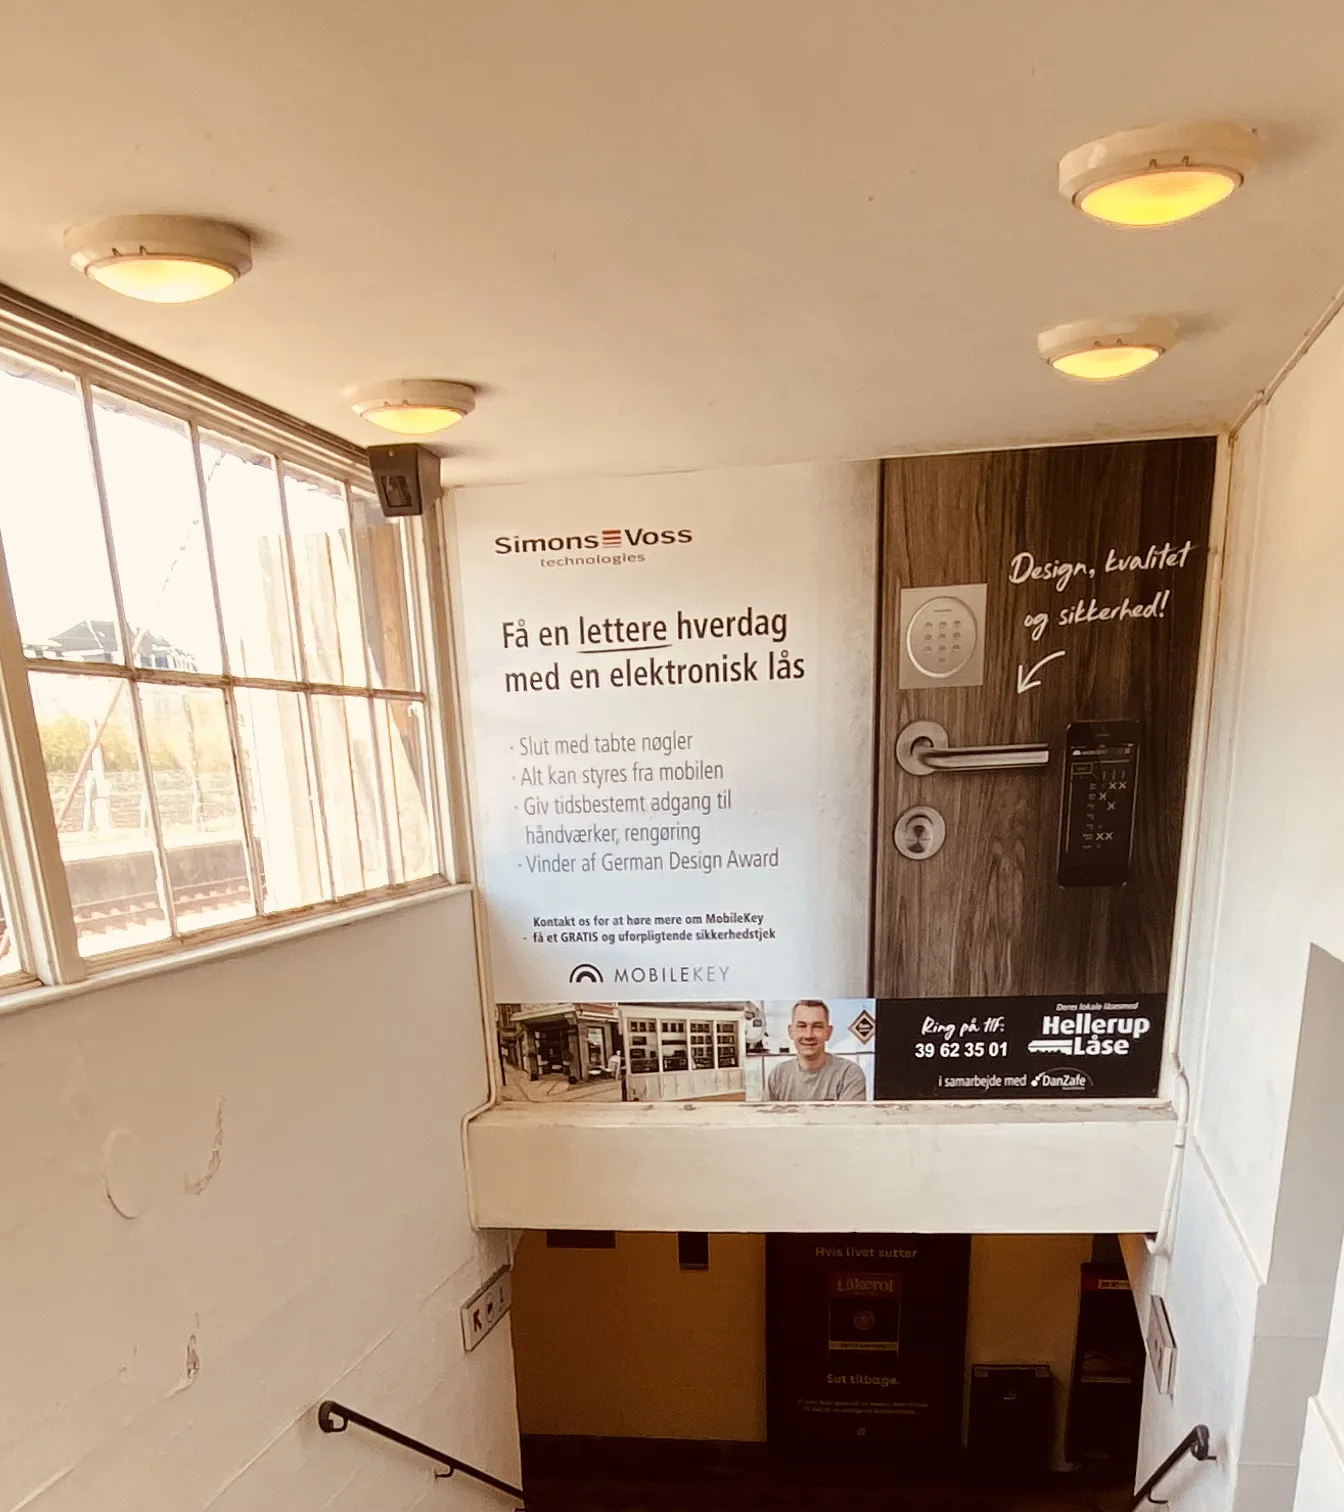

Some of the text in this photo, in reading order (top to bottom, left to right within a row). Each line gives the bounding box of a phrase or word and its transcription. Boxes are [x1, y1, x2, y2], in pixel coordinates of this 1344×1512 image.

[495, 528, 693, 554] Simons Voss
[540, 552, 646, 568] technologies
[1008, 540, 1199, 592] Design, kvalitet
[502, 606, 787, 649] Få en lettere hverdag
[1023, 589, 1171, 641] og sikkerhed!
[505, 649, 805, 693] med en elektronisk lås
[519, 729, 694, 756] Slut med tabte nøgler
[520, 759, 724, 789] Alt kan styres fra mobilen
[524, 788, 732, 816] Giv tidsbestemt adgang til
[525, 820, 701, 846] håndværker, rengøring
[525, 847, 779, 874] Vinder af German Design Award
[533, 912, 764, 927] Kontakt os for at høre mere om MobileKey
[533, 928, 776, 945] få et GRATIS og uforpligtende sikkerhedstjek
[614, 966, 730, 984] MOBILEKEY
[921, 1015, 956, 1040] Ring
[959, 1016, 981, 1038] på
[1042, 1012, 1151, 1039] Hellerup
[915, 1041, 1008, 1058] 39 62 35 01
[1072, 1036, 1130, 1056] Låse
[944, 1073, 1002, 1091] samarbejde
[1004, 1073, 1027, 1087] med
[1042, 1072, 1086, 1088] DanZafe
[815, 1245, 919, 1259] Hvis livet sutter
[826, 1372, 900, 1387] Sut tilbage.
